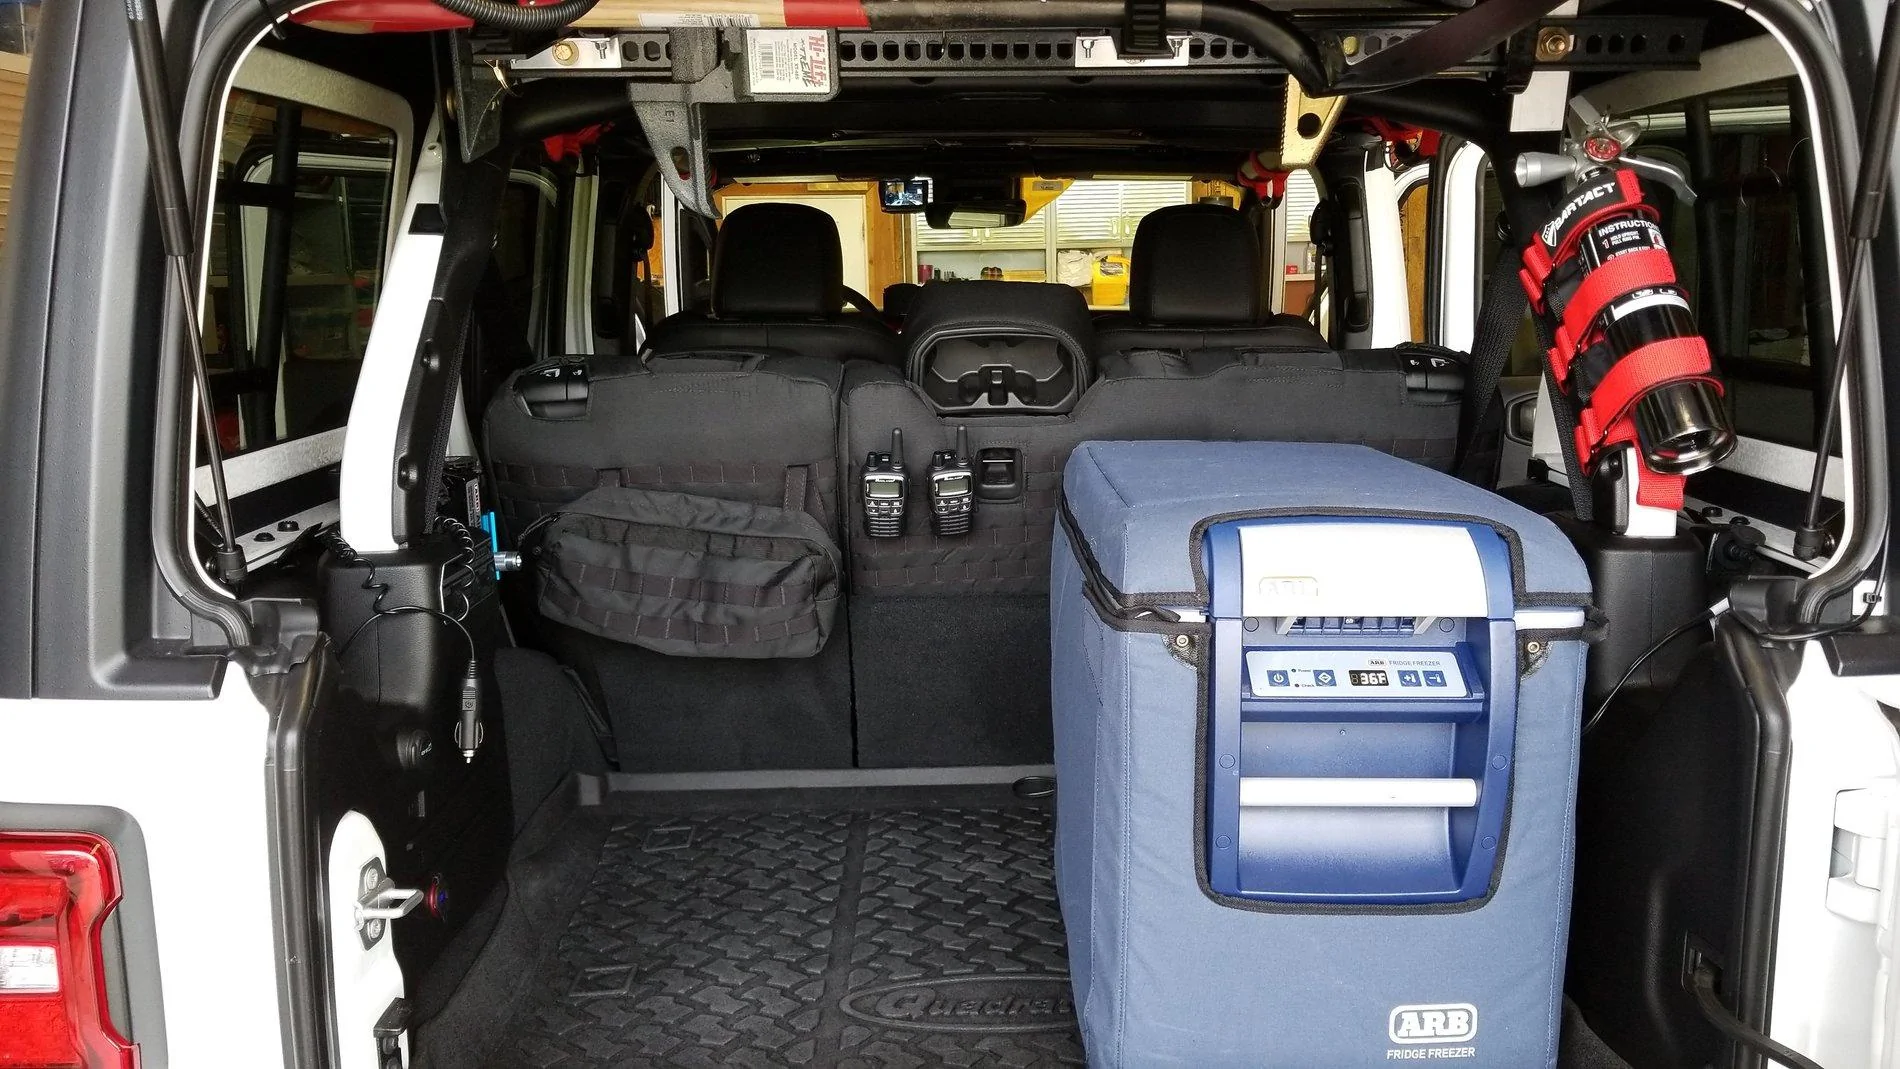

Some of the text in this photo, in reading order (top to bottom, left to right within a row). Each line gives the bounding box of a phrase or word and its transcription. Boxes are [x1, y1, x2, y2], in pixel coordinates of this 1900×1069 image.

[808, 35, 827, 87] Hi-Lift
[1553, 182, 1615, 231] BARTACT
[1397, 1009, 1470, 1038] ARB
[1386, 1047, 1476, 1060] FRIDGE FREEZER
